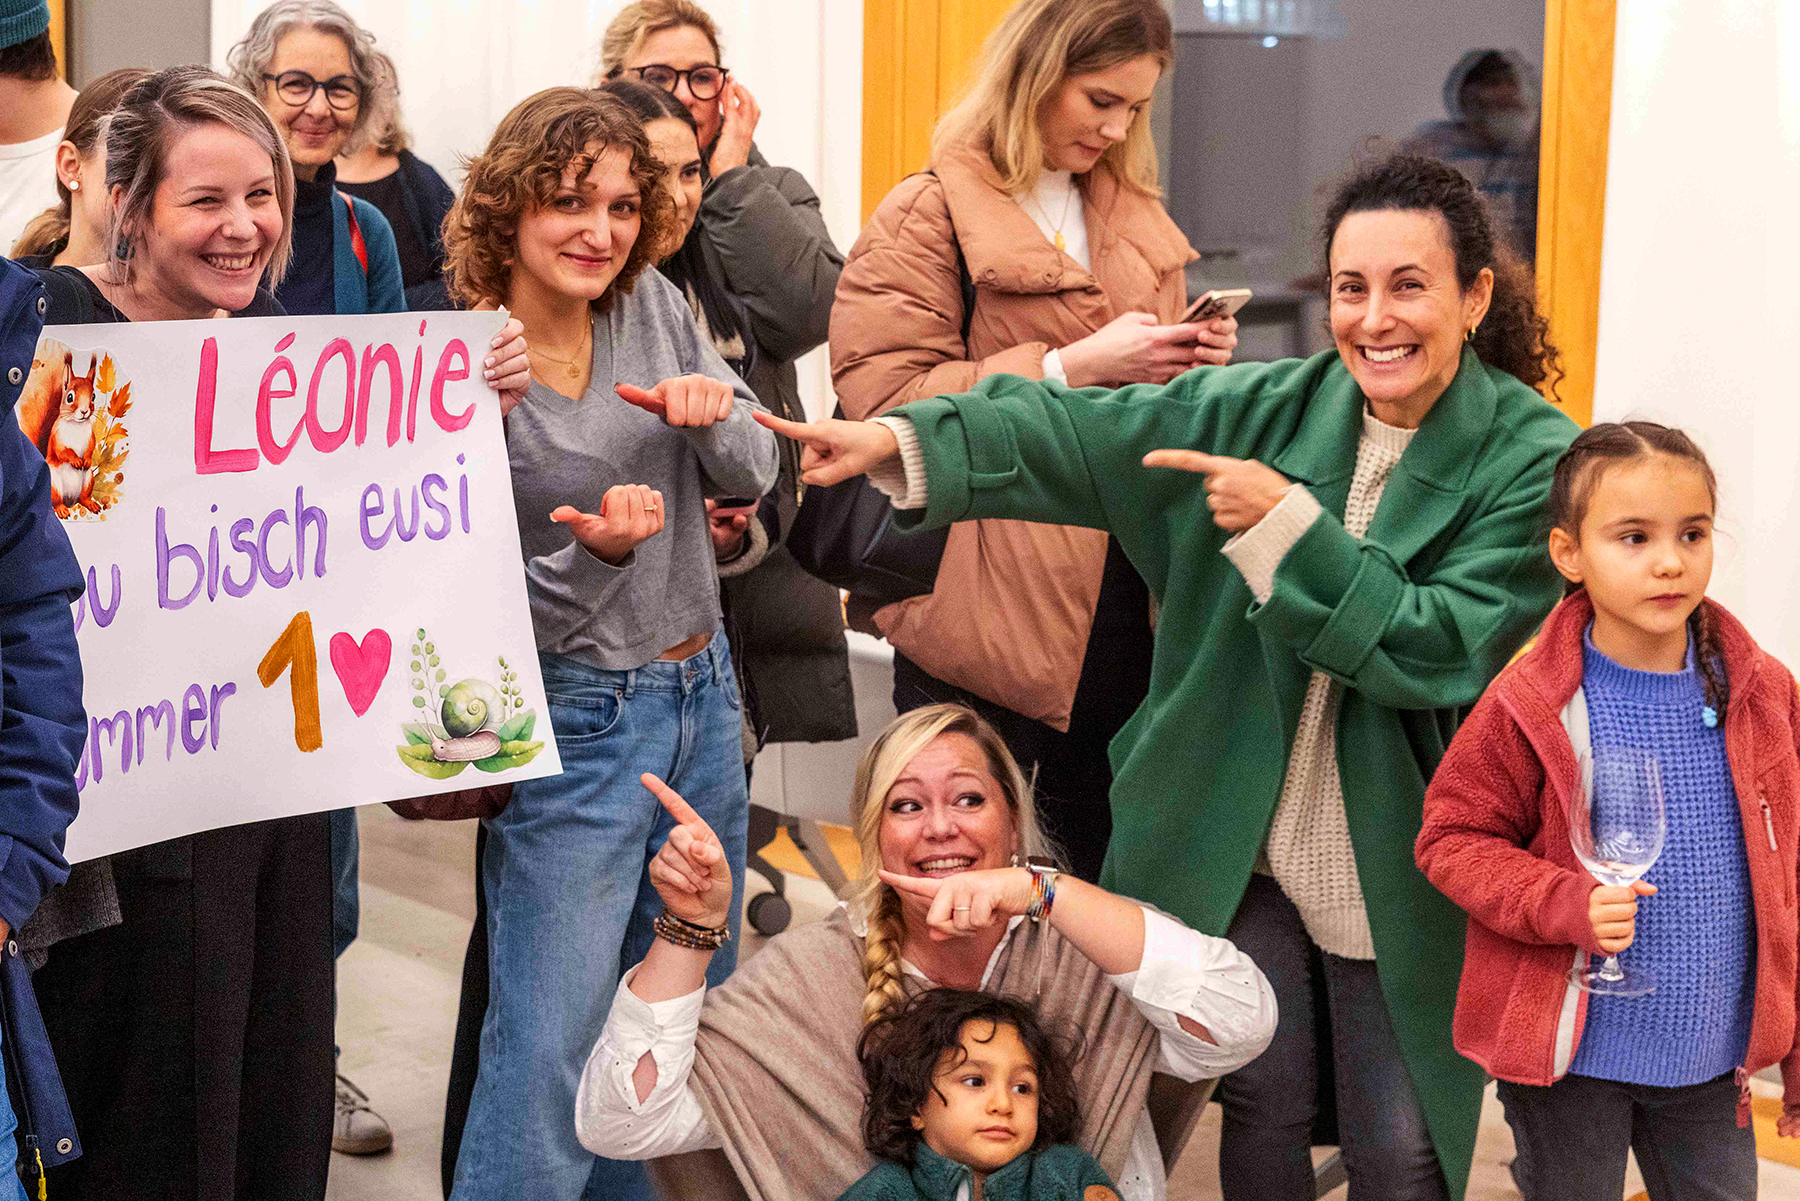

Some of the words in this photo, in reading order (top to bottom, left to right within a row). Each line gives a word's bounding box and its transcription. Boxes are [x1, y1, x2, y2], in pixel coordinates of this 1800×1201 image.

[194, 319, 477, 475] Léonie
[155, 484, 327, 610] bisch
[359, 452, 470, 551] eusi
[256, 610, 324, 753] 1
